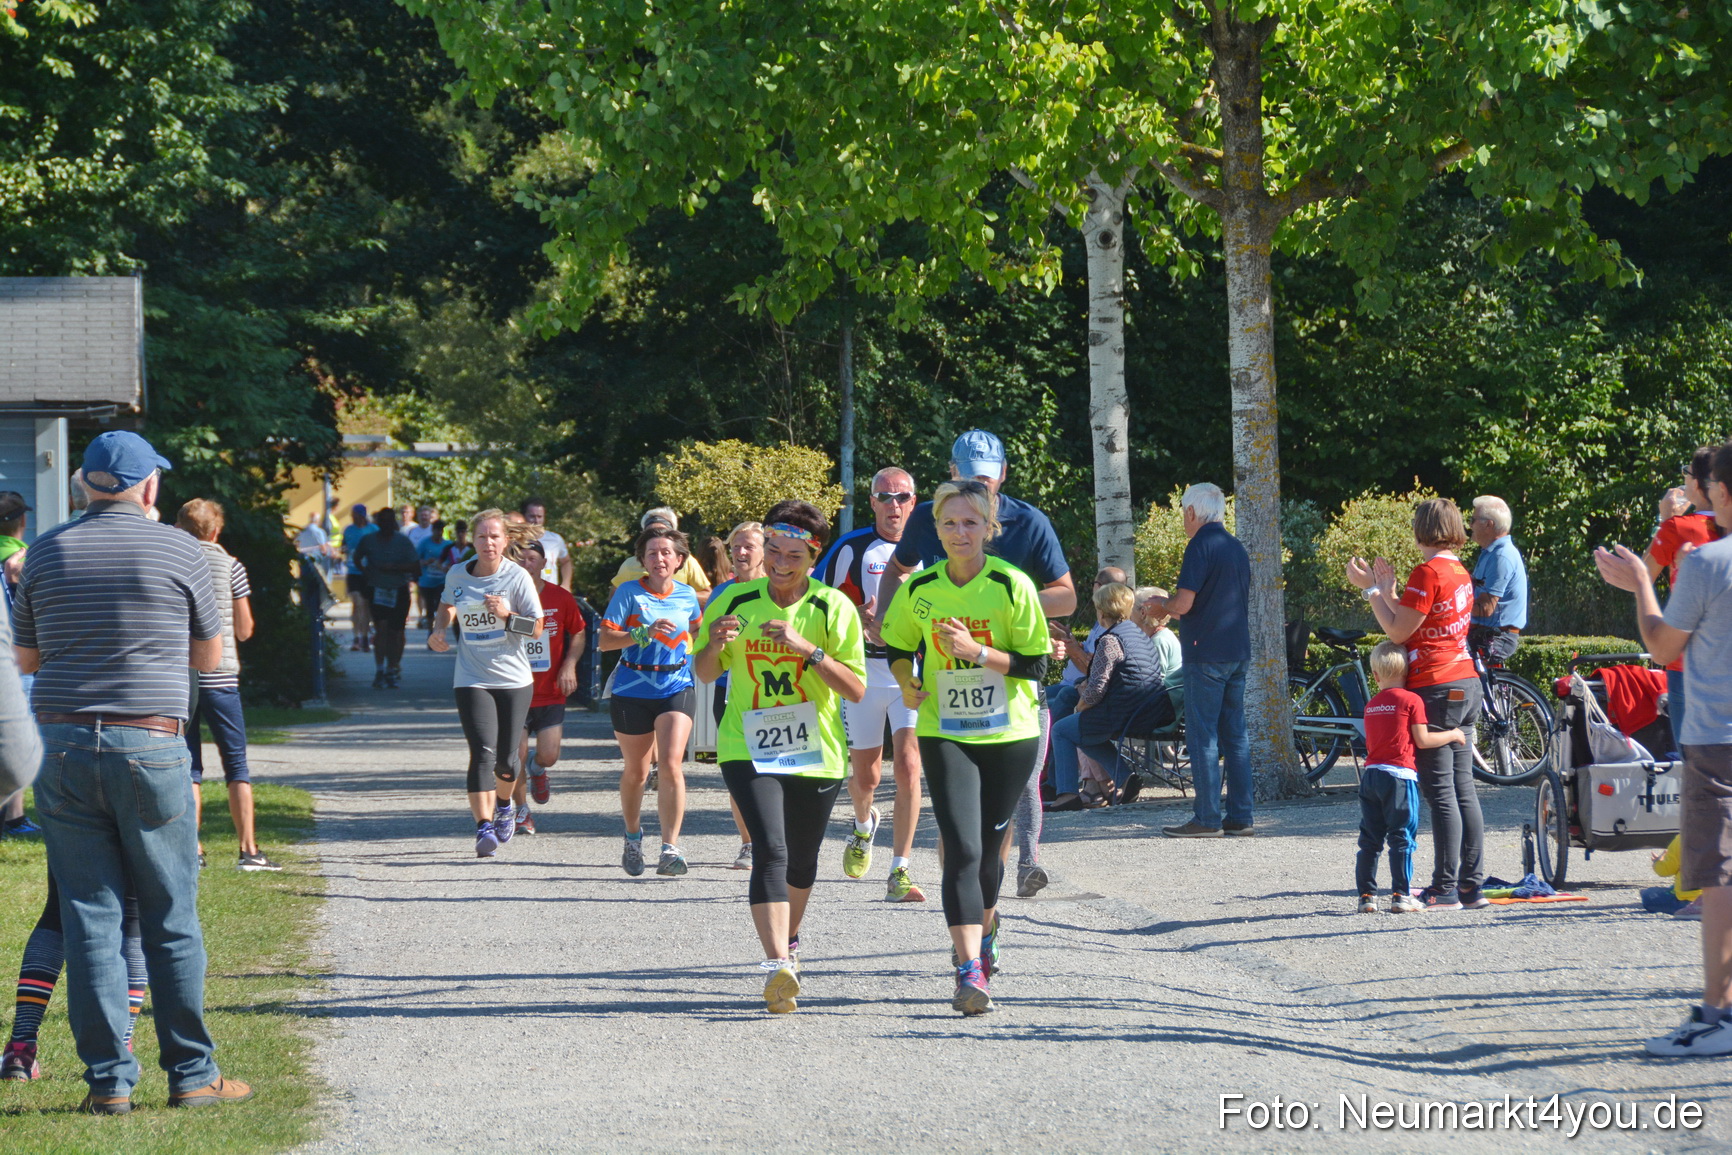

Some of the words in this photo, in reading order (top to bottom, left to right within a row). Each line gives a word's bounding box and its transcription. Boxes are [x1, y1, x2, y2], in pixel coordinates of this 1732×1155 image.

[463, 612, 497, 627] 2546
[524, 641, 543, 655] 86
[745, 639, 801, 655] Mülle
[761, 670, 795, 697] M
[947, 686, 995, 708] 2187
[960, 719, 991, 729] Monika
[755, 722, 809, 750] 2214
[778, 757, 796, 767] Rita
